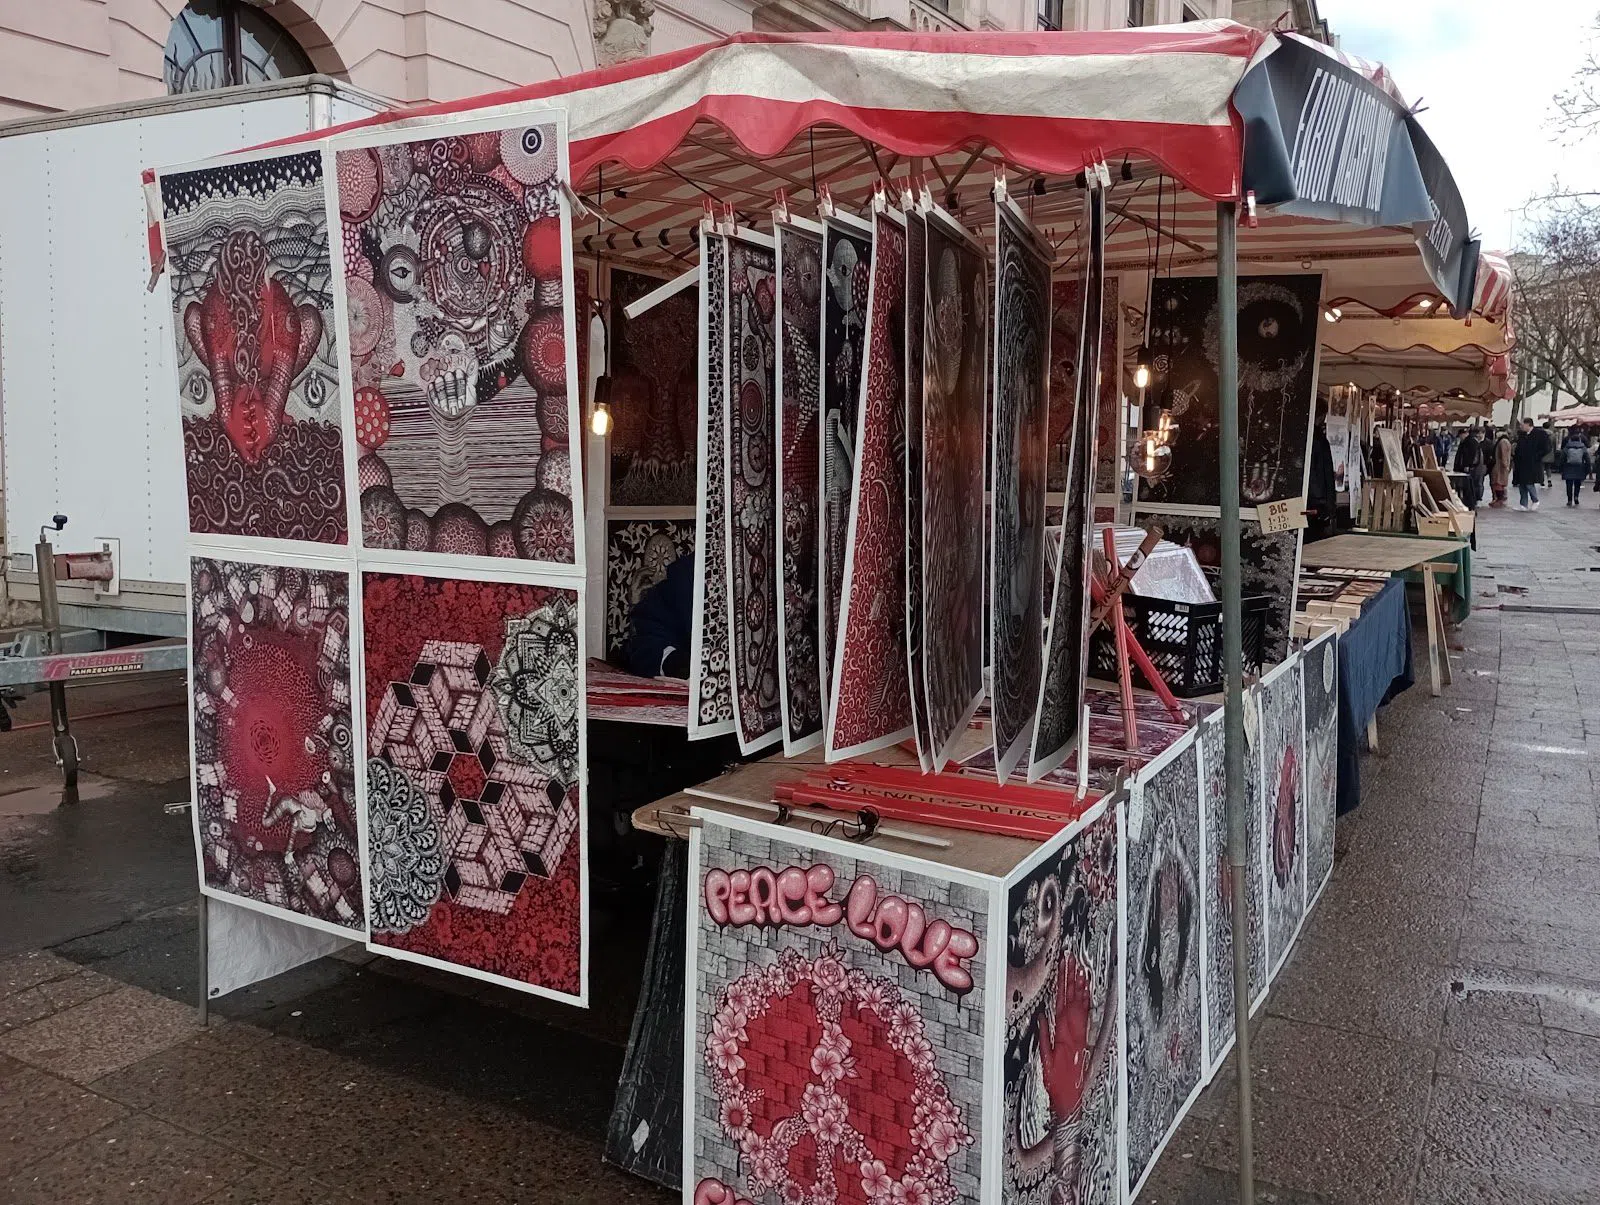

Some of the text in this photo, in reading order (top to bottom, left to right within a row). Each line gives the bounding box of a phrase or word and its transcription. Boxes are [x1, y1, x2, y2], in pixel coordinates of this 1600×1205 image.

[1291, 67, 1353, 202] FARUK
[1330, 87, 1380, 208] MASRI
[70, 664, 143, 676] FAHRZEUGFABRIK
[704, 863, 980, 994] PEACE LOVE
